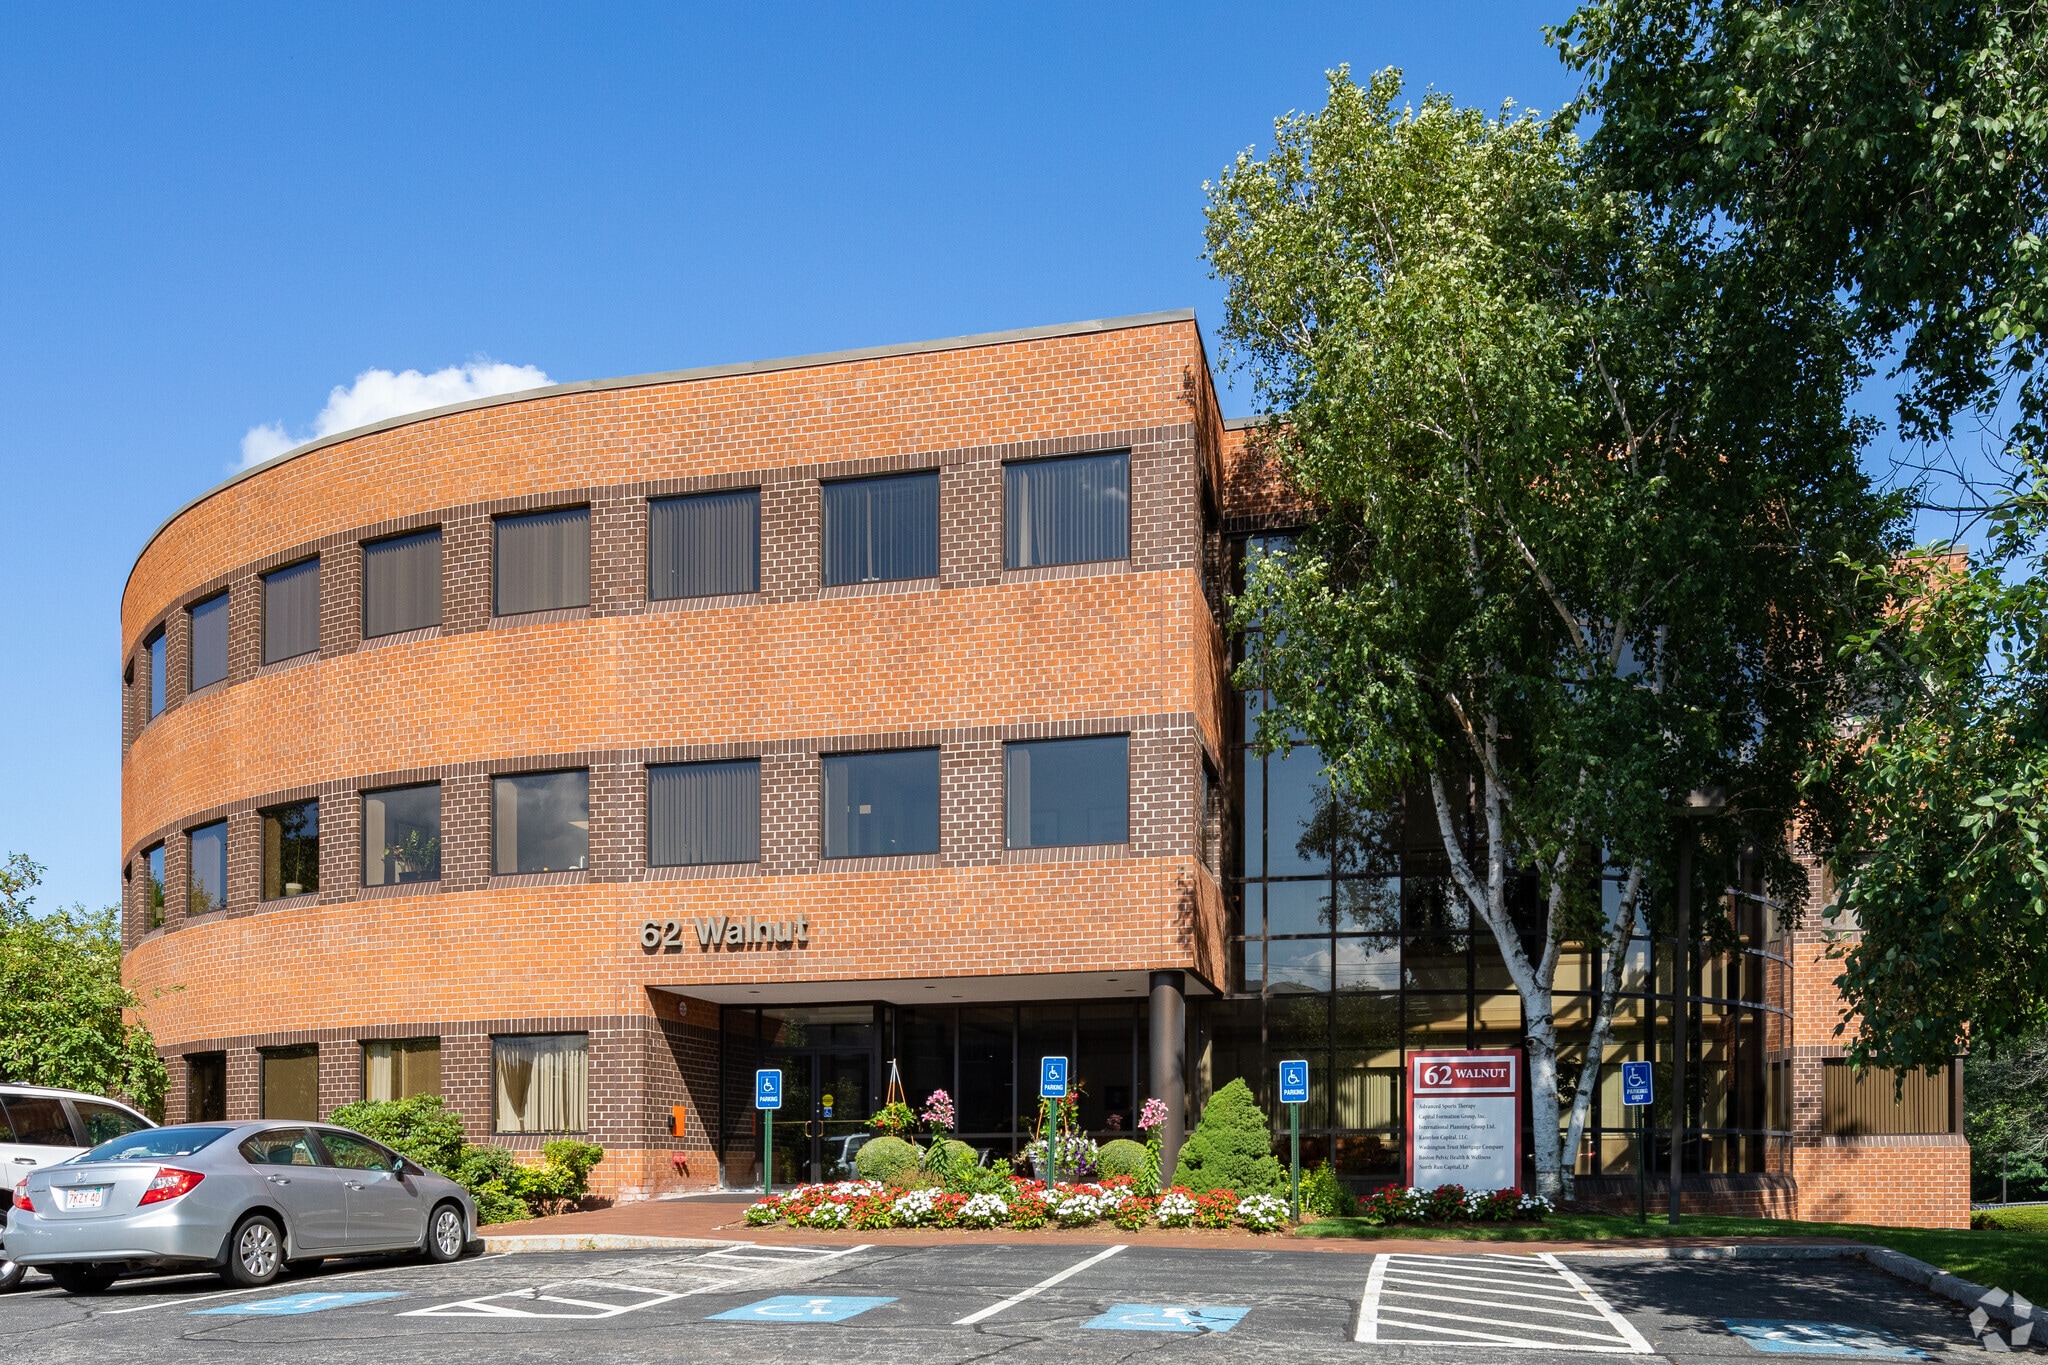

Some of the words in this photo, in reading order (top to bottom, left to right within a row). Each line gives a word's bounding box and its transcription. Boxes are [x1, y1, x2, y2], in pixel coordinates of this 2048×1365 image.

[641, 919, 683, 948] 62
[695, 914, 808, 945] Walnut
[1424, 1065, 1453, 1085] 62
[1455, 1068, 1506, 1078] WALNUT
